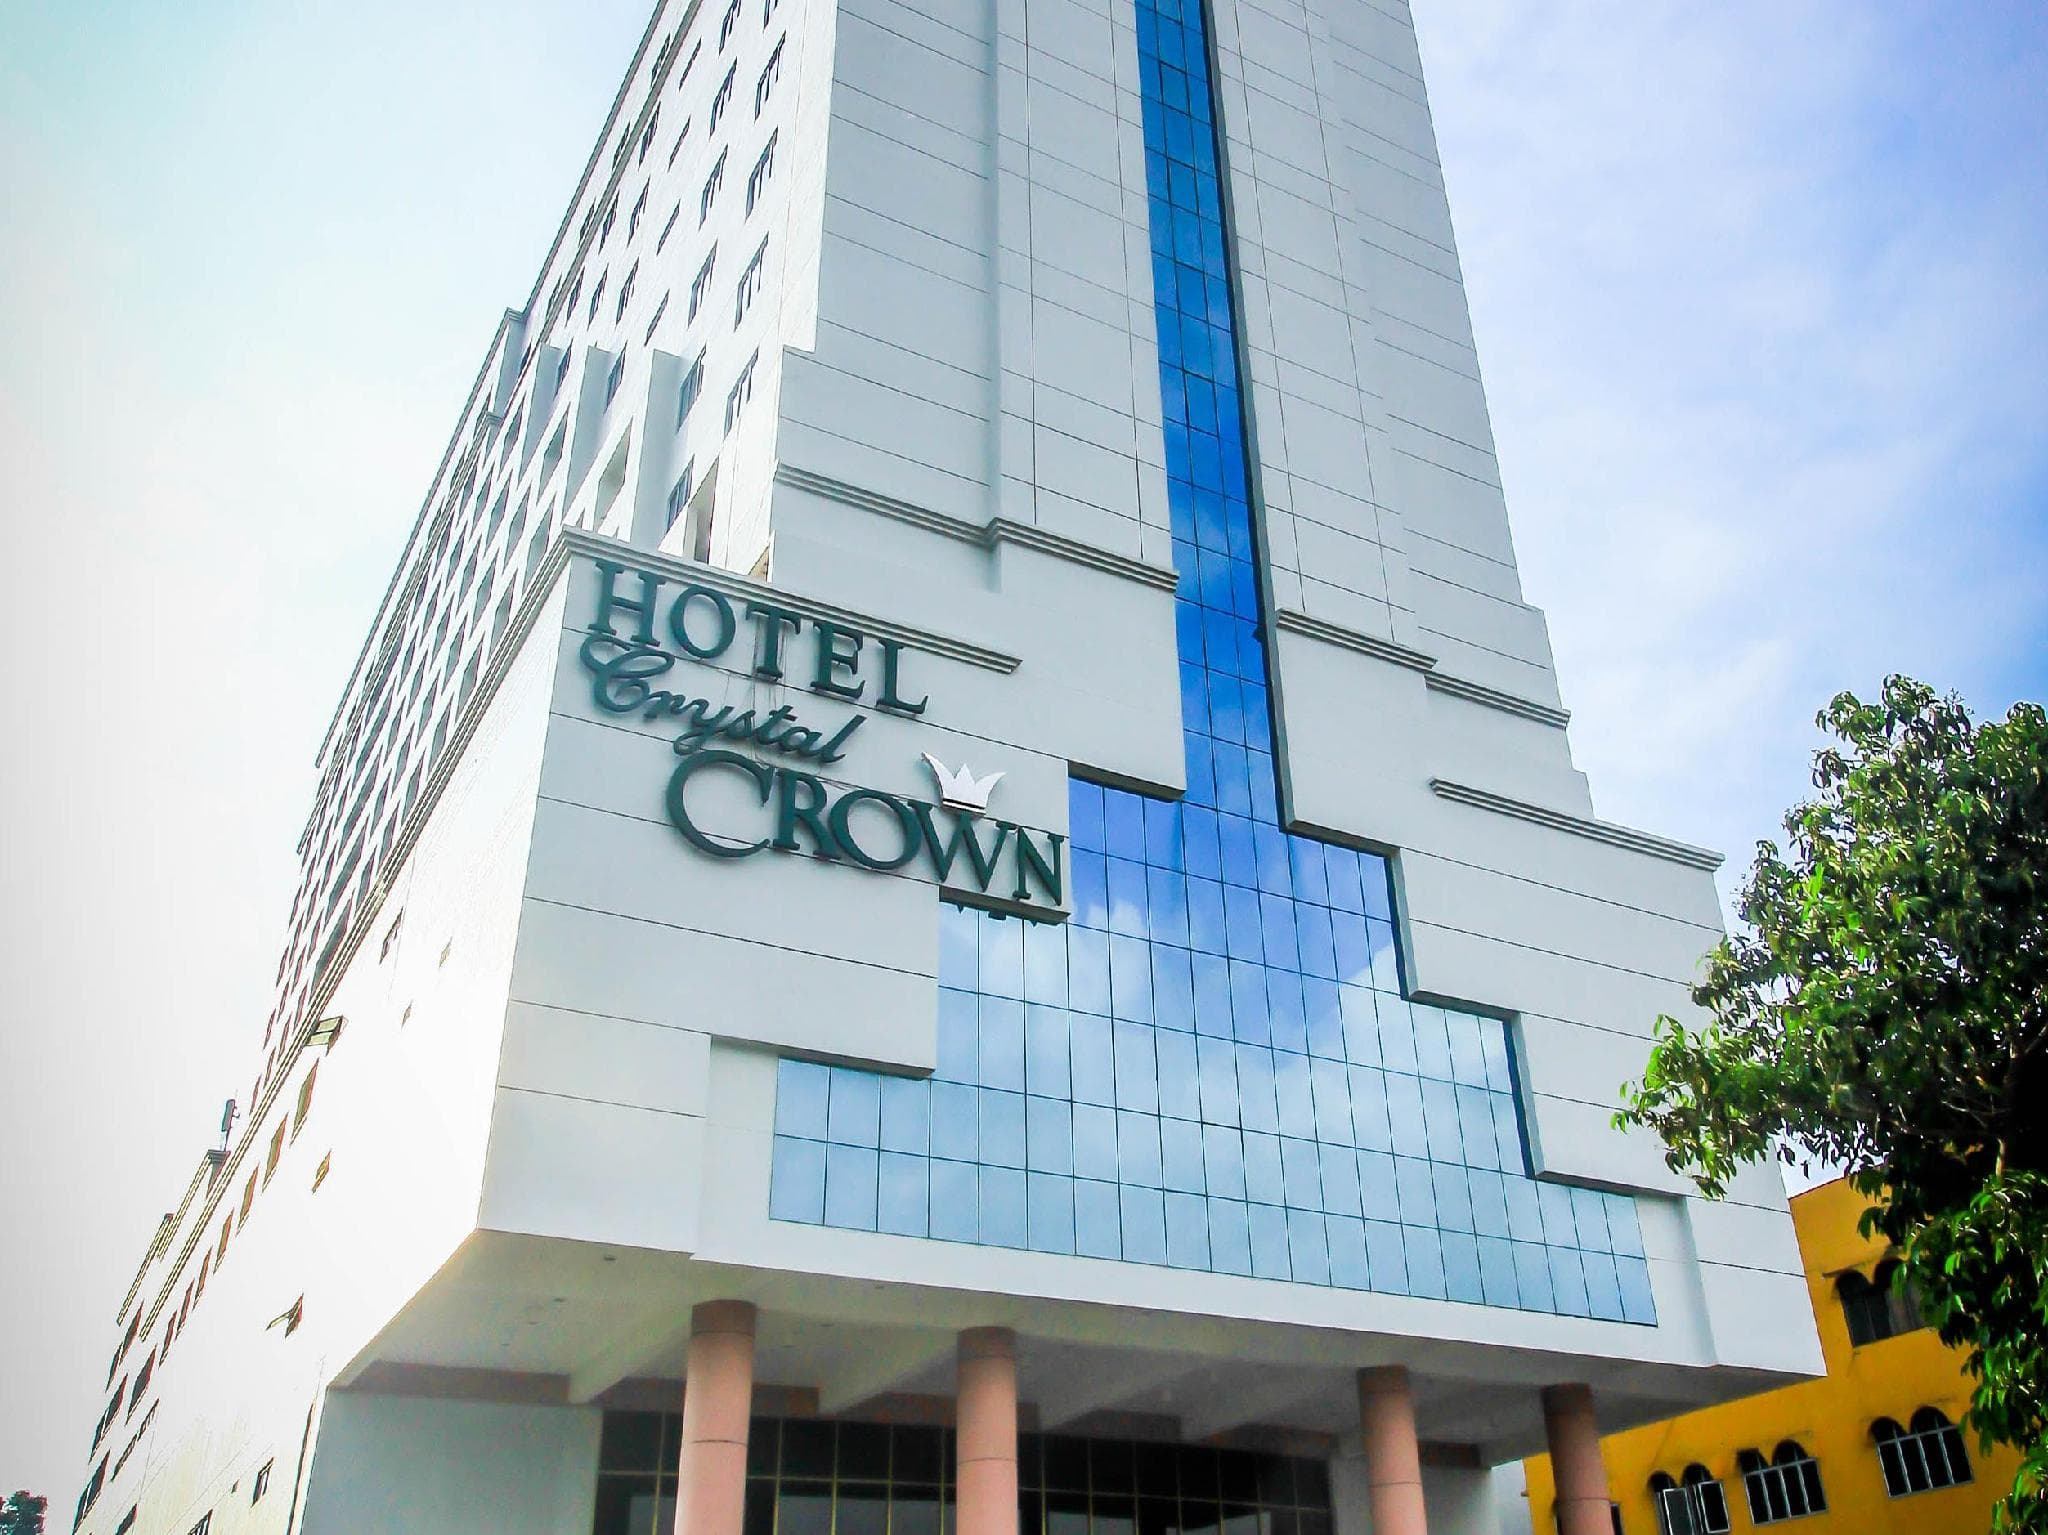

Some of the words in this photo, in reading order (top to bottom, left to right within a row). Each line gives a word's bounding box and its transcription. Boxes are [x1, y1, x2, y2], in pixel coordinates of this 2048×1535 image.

[580, 633, 866, 763] Crystal
[588, 560, 929, 715] HOTEL
[666, 749, 1064, 906] CROWN
